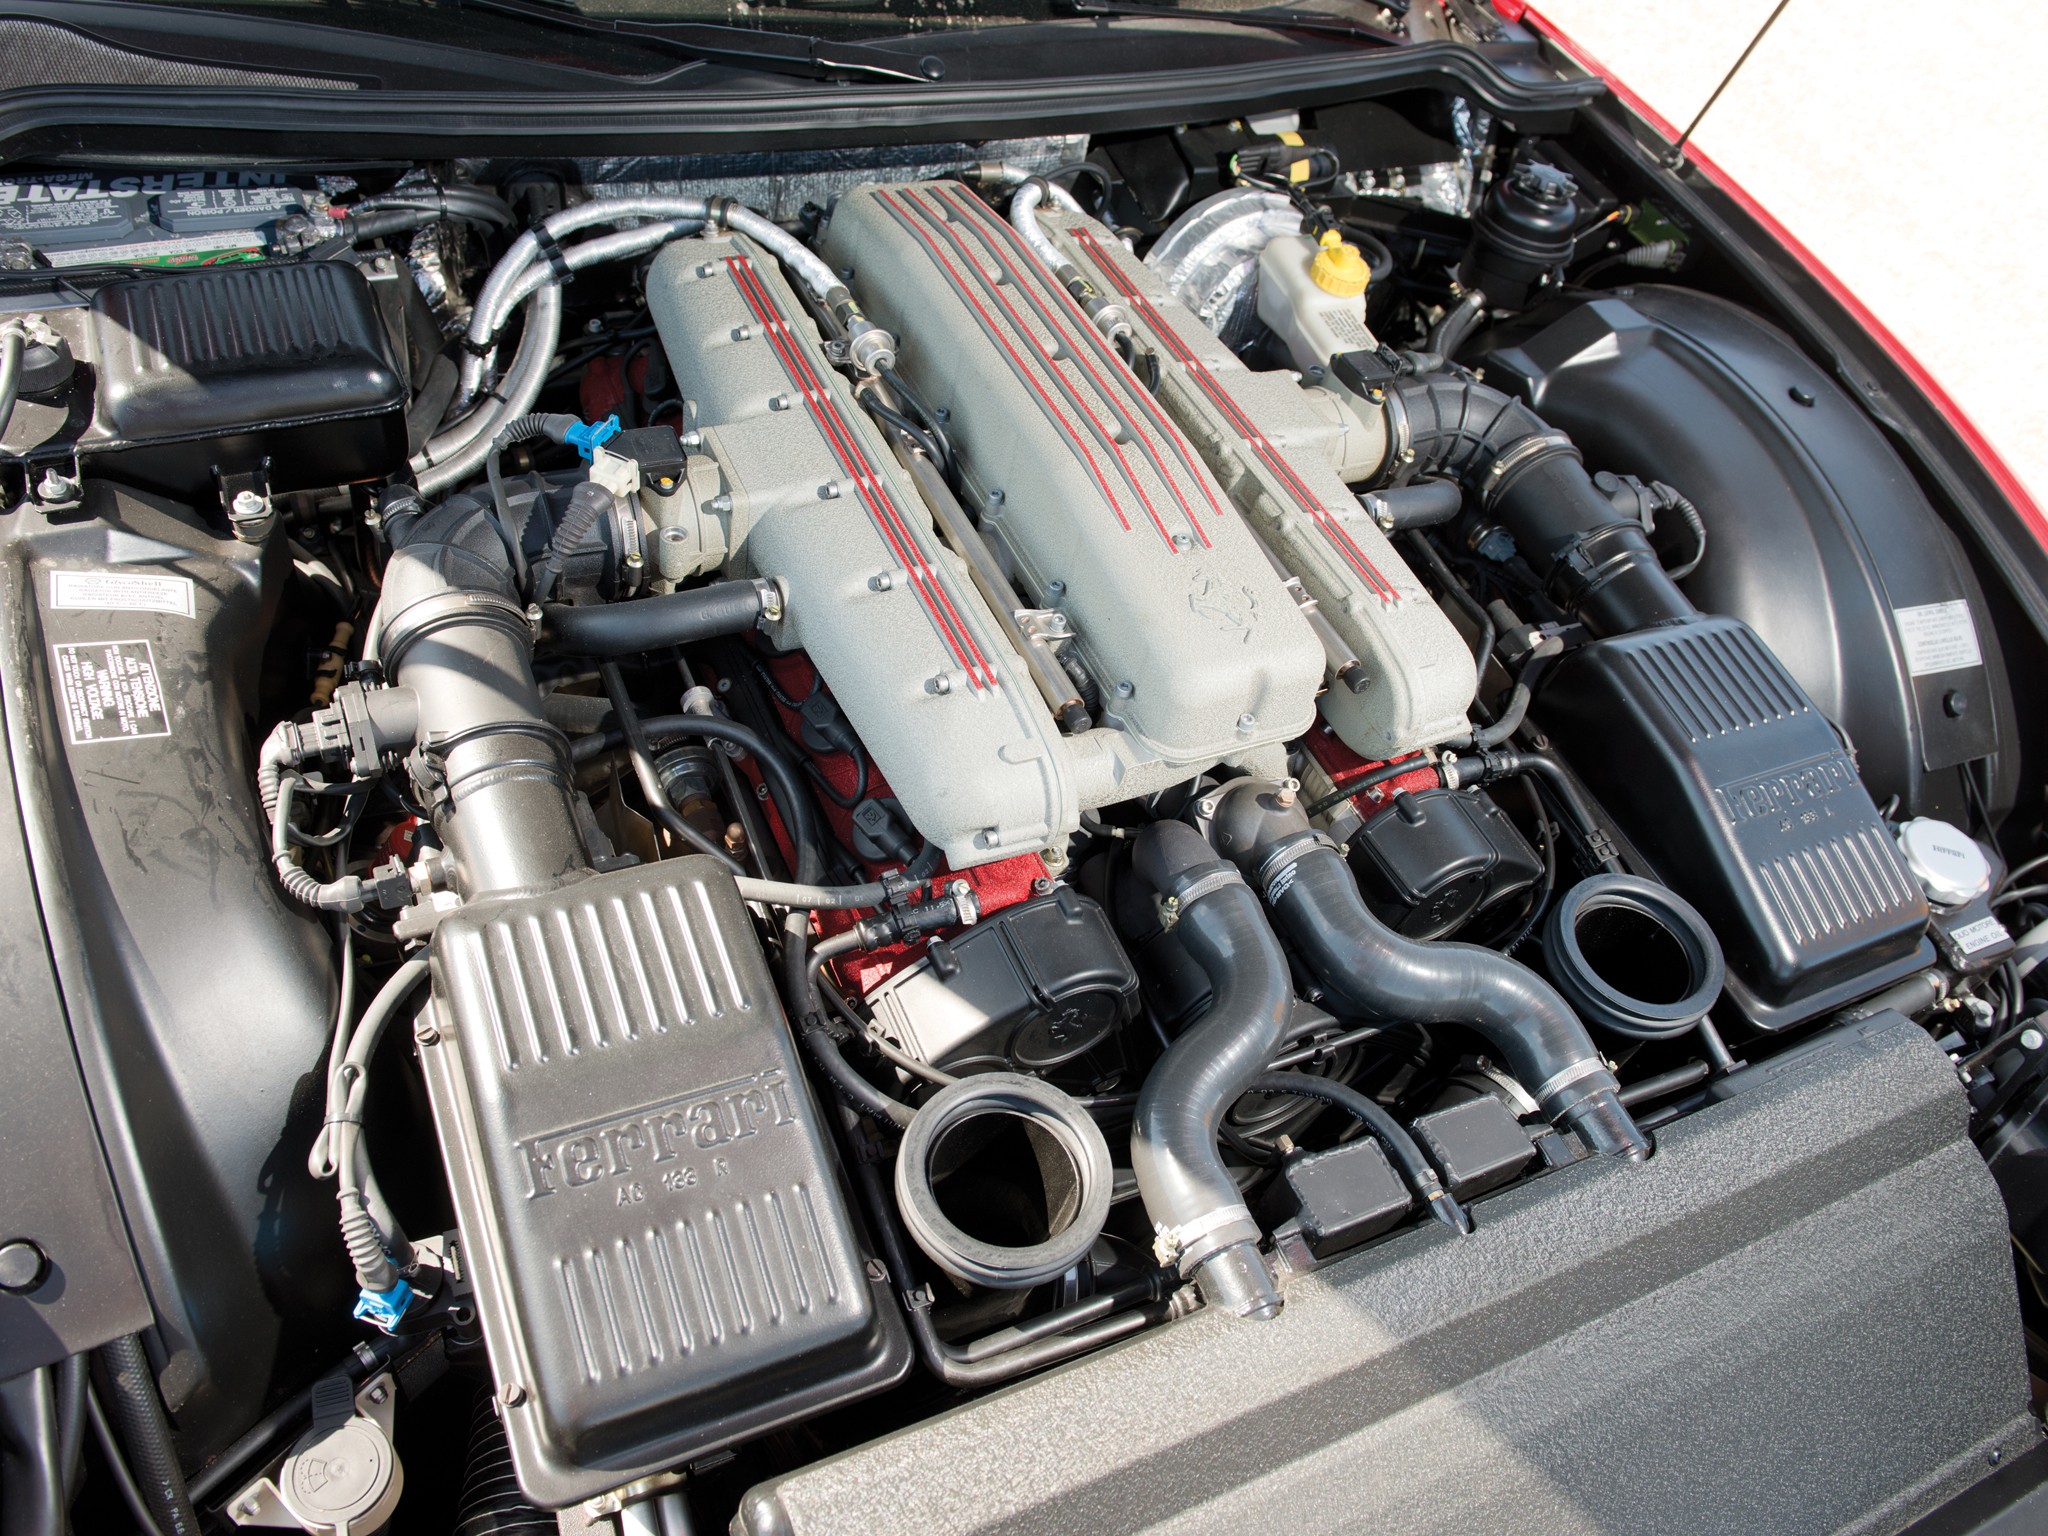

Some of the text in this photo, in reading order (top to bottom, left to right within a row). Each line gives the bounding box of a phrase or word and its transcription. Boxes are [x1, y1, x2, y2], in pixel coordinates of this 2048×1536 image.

[0, 172, 94, 187] MEGA-TRO
[80, 661, 105, 720] HIGH VOLTAGE
[96, 669, 116, 708] WARNING
[124, 656, 149, 718] ALTA TENSIONE
[139, 662, 161, 712] ATTENZIONE
[1714, 749, 1859, 826] Ferrari
[1932, 844, 1966, 859] Ferrari
[514, 1067, 798, 1201] Ferrari
[616, 1156, 730, 1208] AC 133 R
